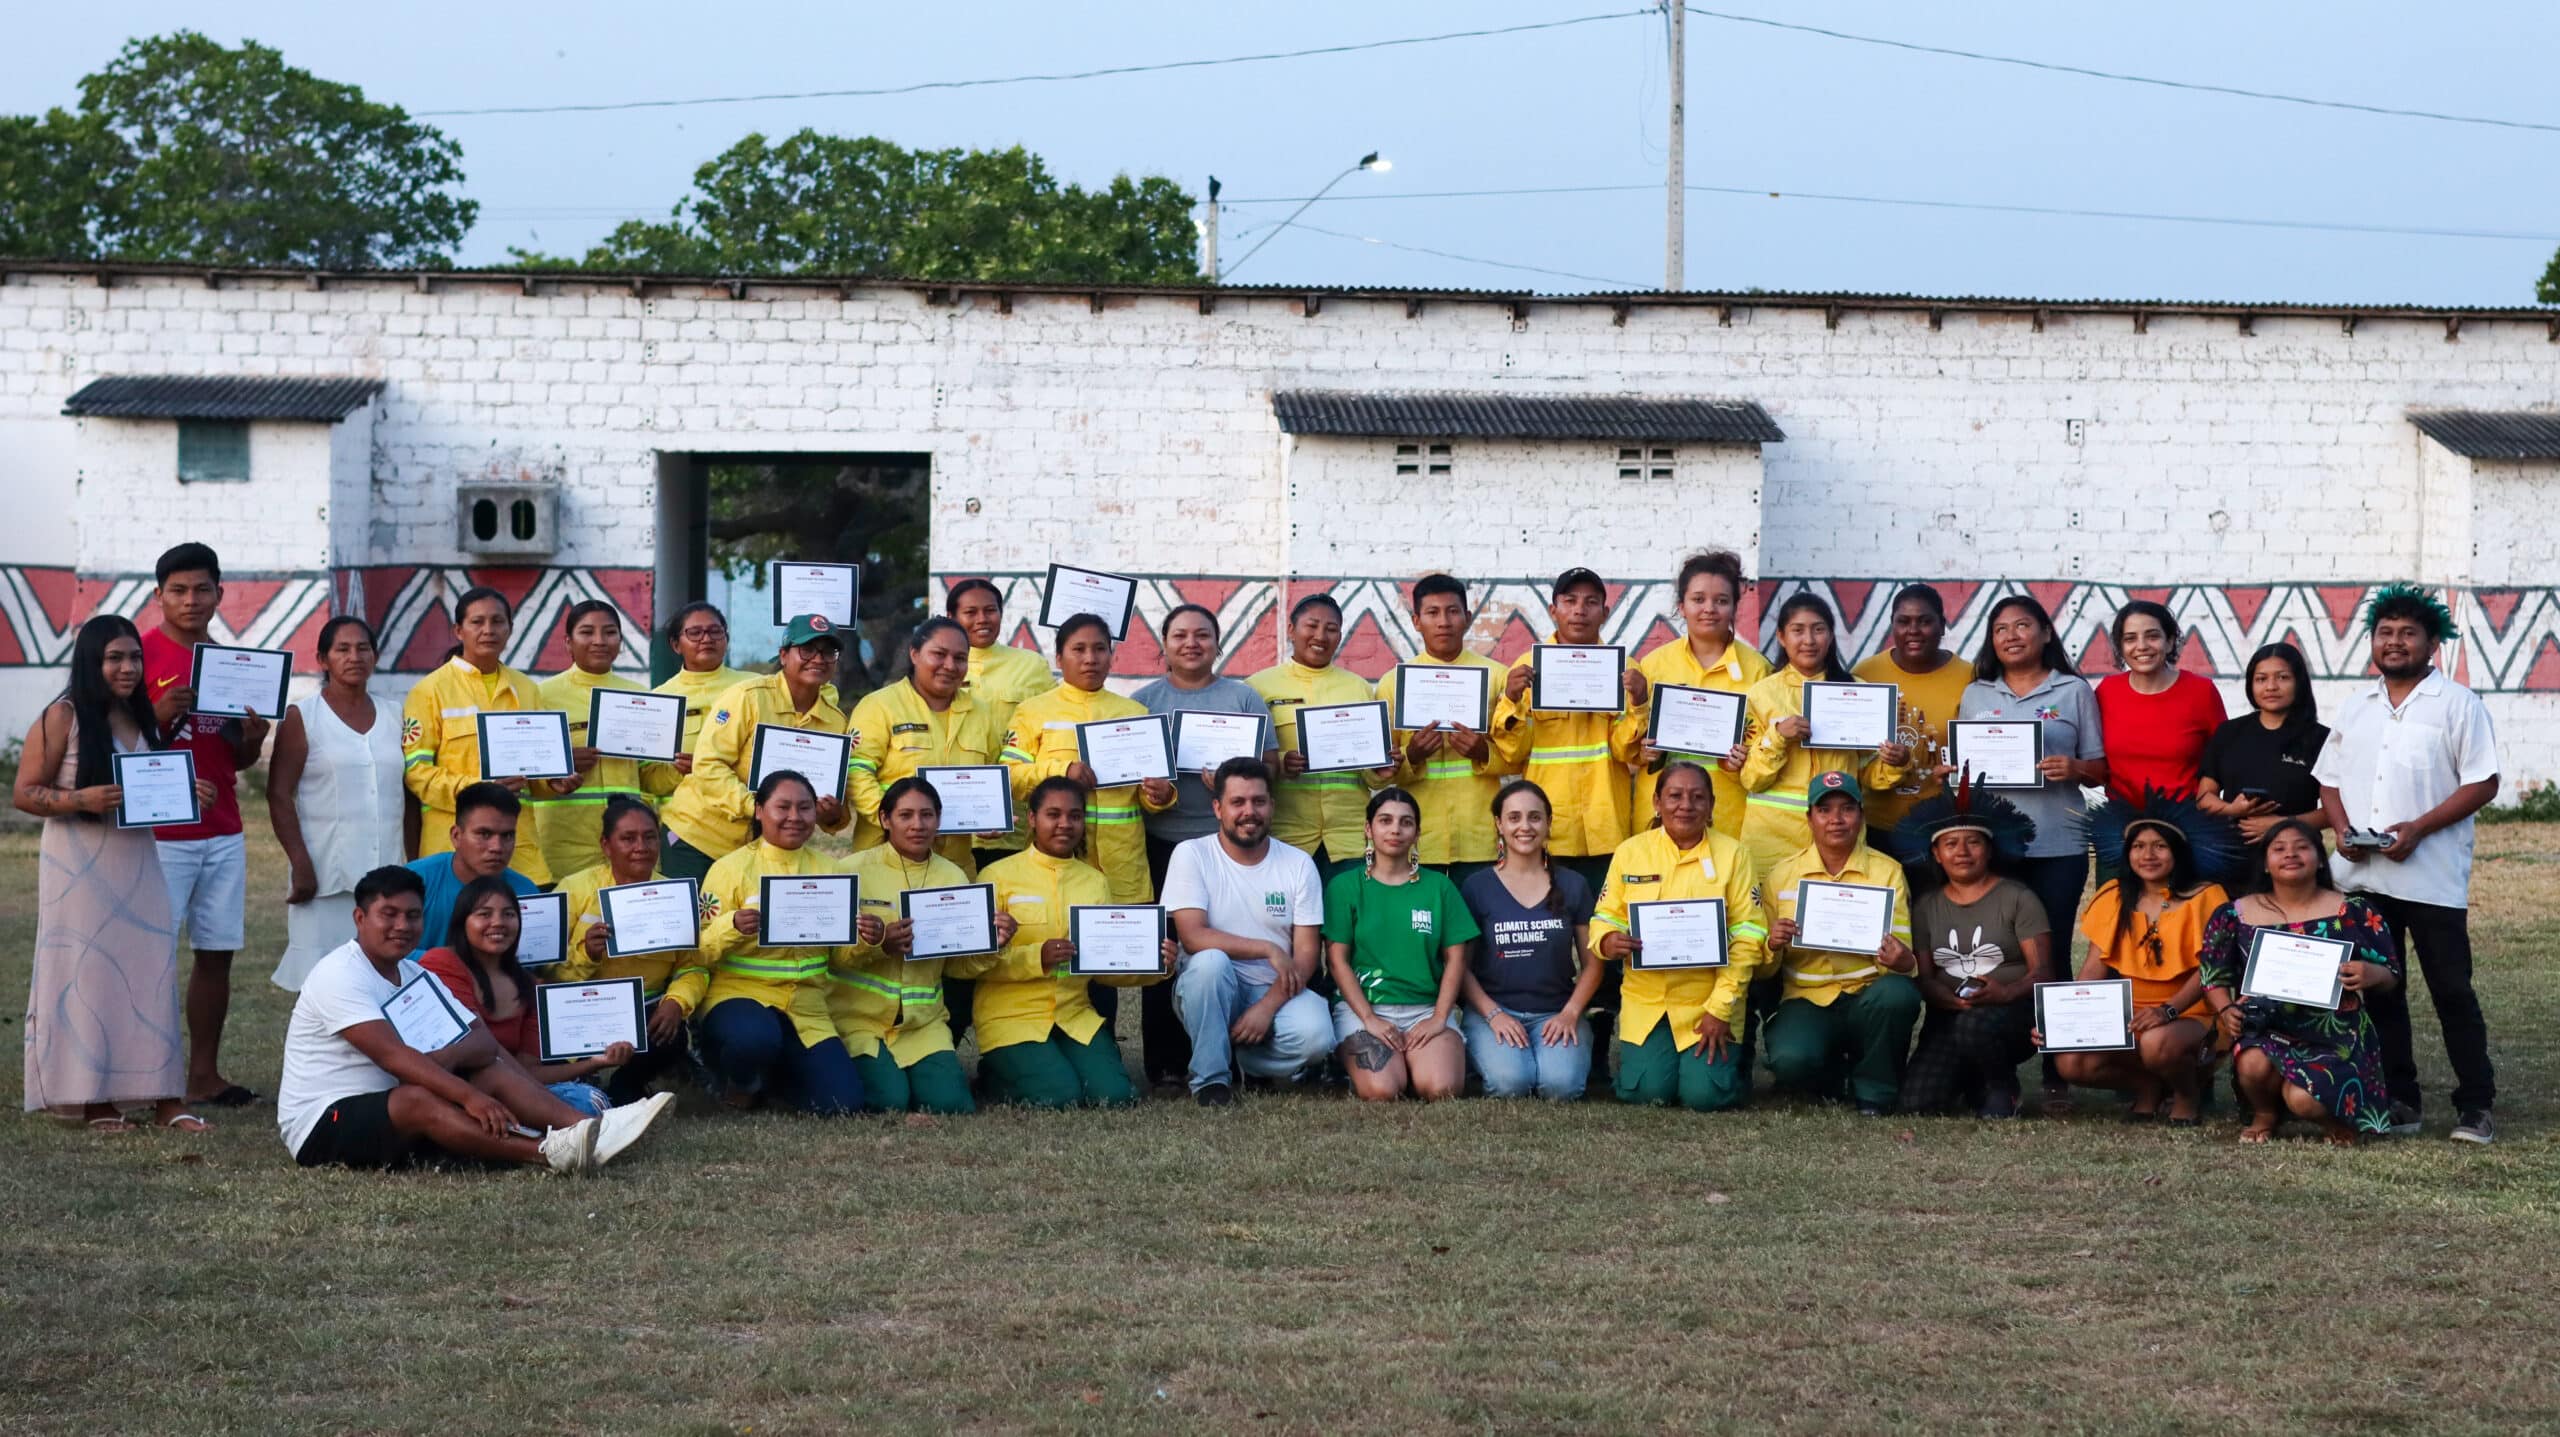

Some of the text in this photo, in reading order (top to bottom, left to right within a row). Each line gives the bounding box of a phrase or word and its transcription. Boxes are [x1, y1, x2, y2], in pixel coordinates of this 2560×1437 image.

[1412, 922, 1432, 930] IPAM
[1494, 919, 1563, 933] CLIMATE SCIENCE
[1495, 931, 1548, 945] FOR CHANGE.
